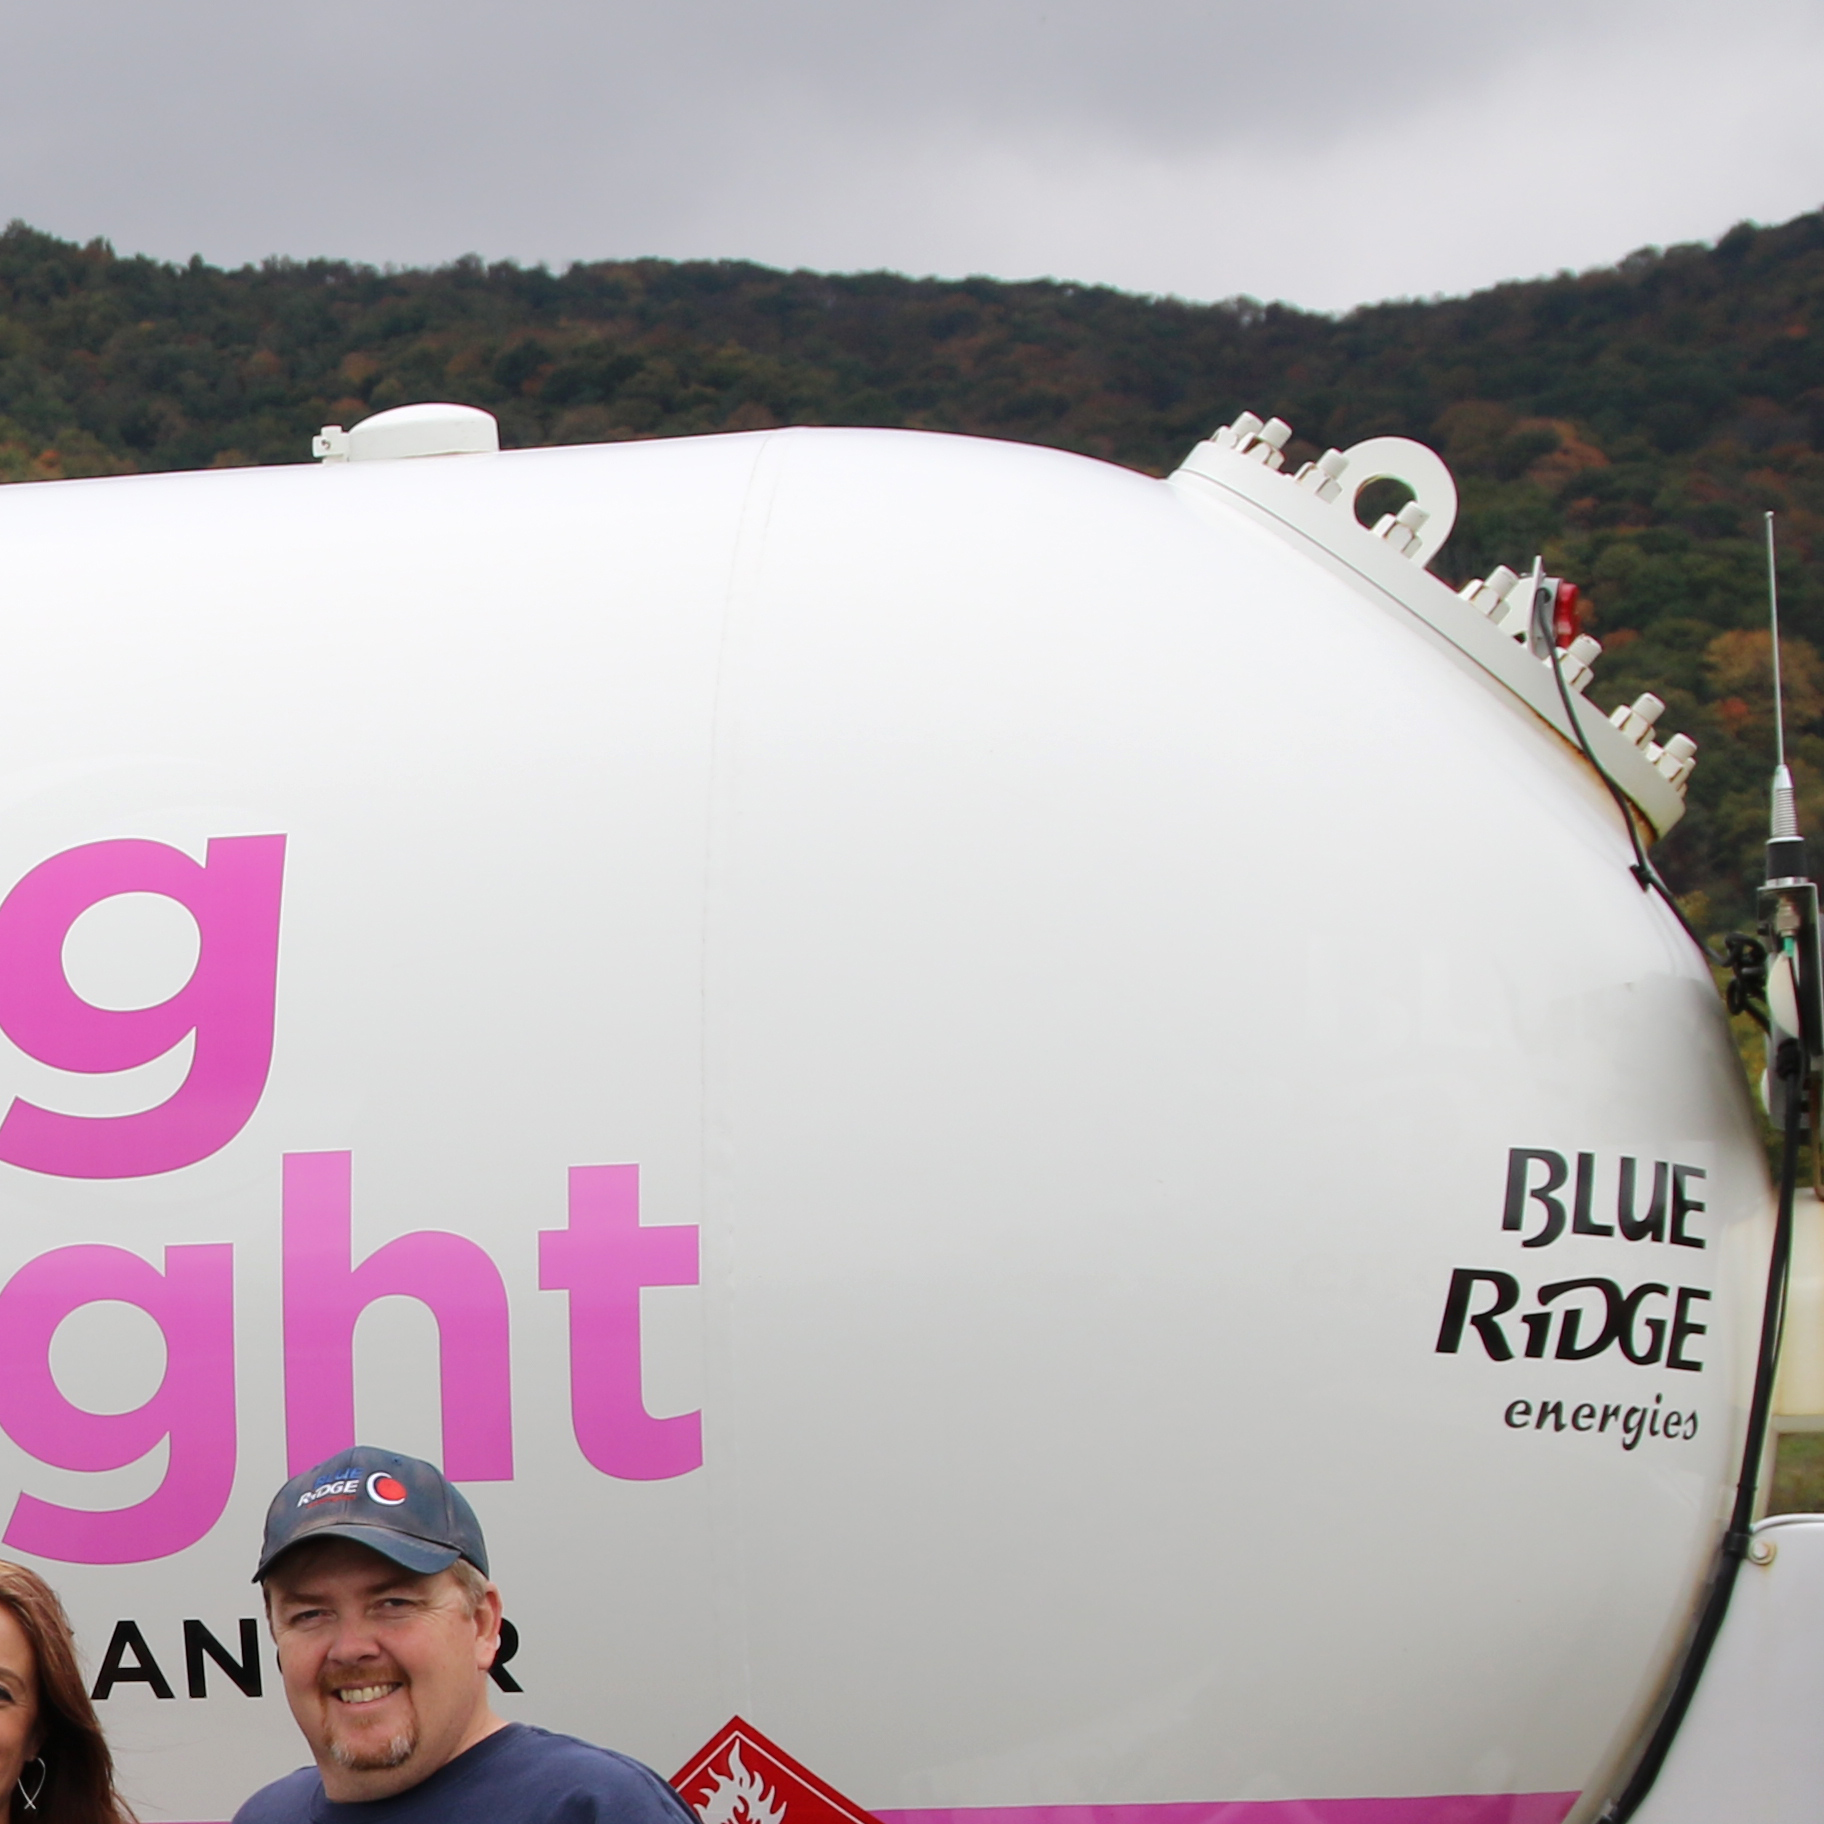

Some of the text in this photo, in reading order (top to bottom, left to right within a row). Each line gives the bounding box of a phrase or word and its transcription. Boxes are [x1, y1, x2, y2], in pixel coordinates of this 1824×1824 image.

[1503, 1148, 1706, 1248] BLUE
[1435, 1268, 1711, 1371] RIDGE
[1504, 1393, 1698, 1451] energies
[296, 1479, 360, 1508] RIDGE
